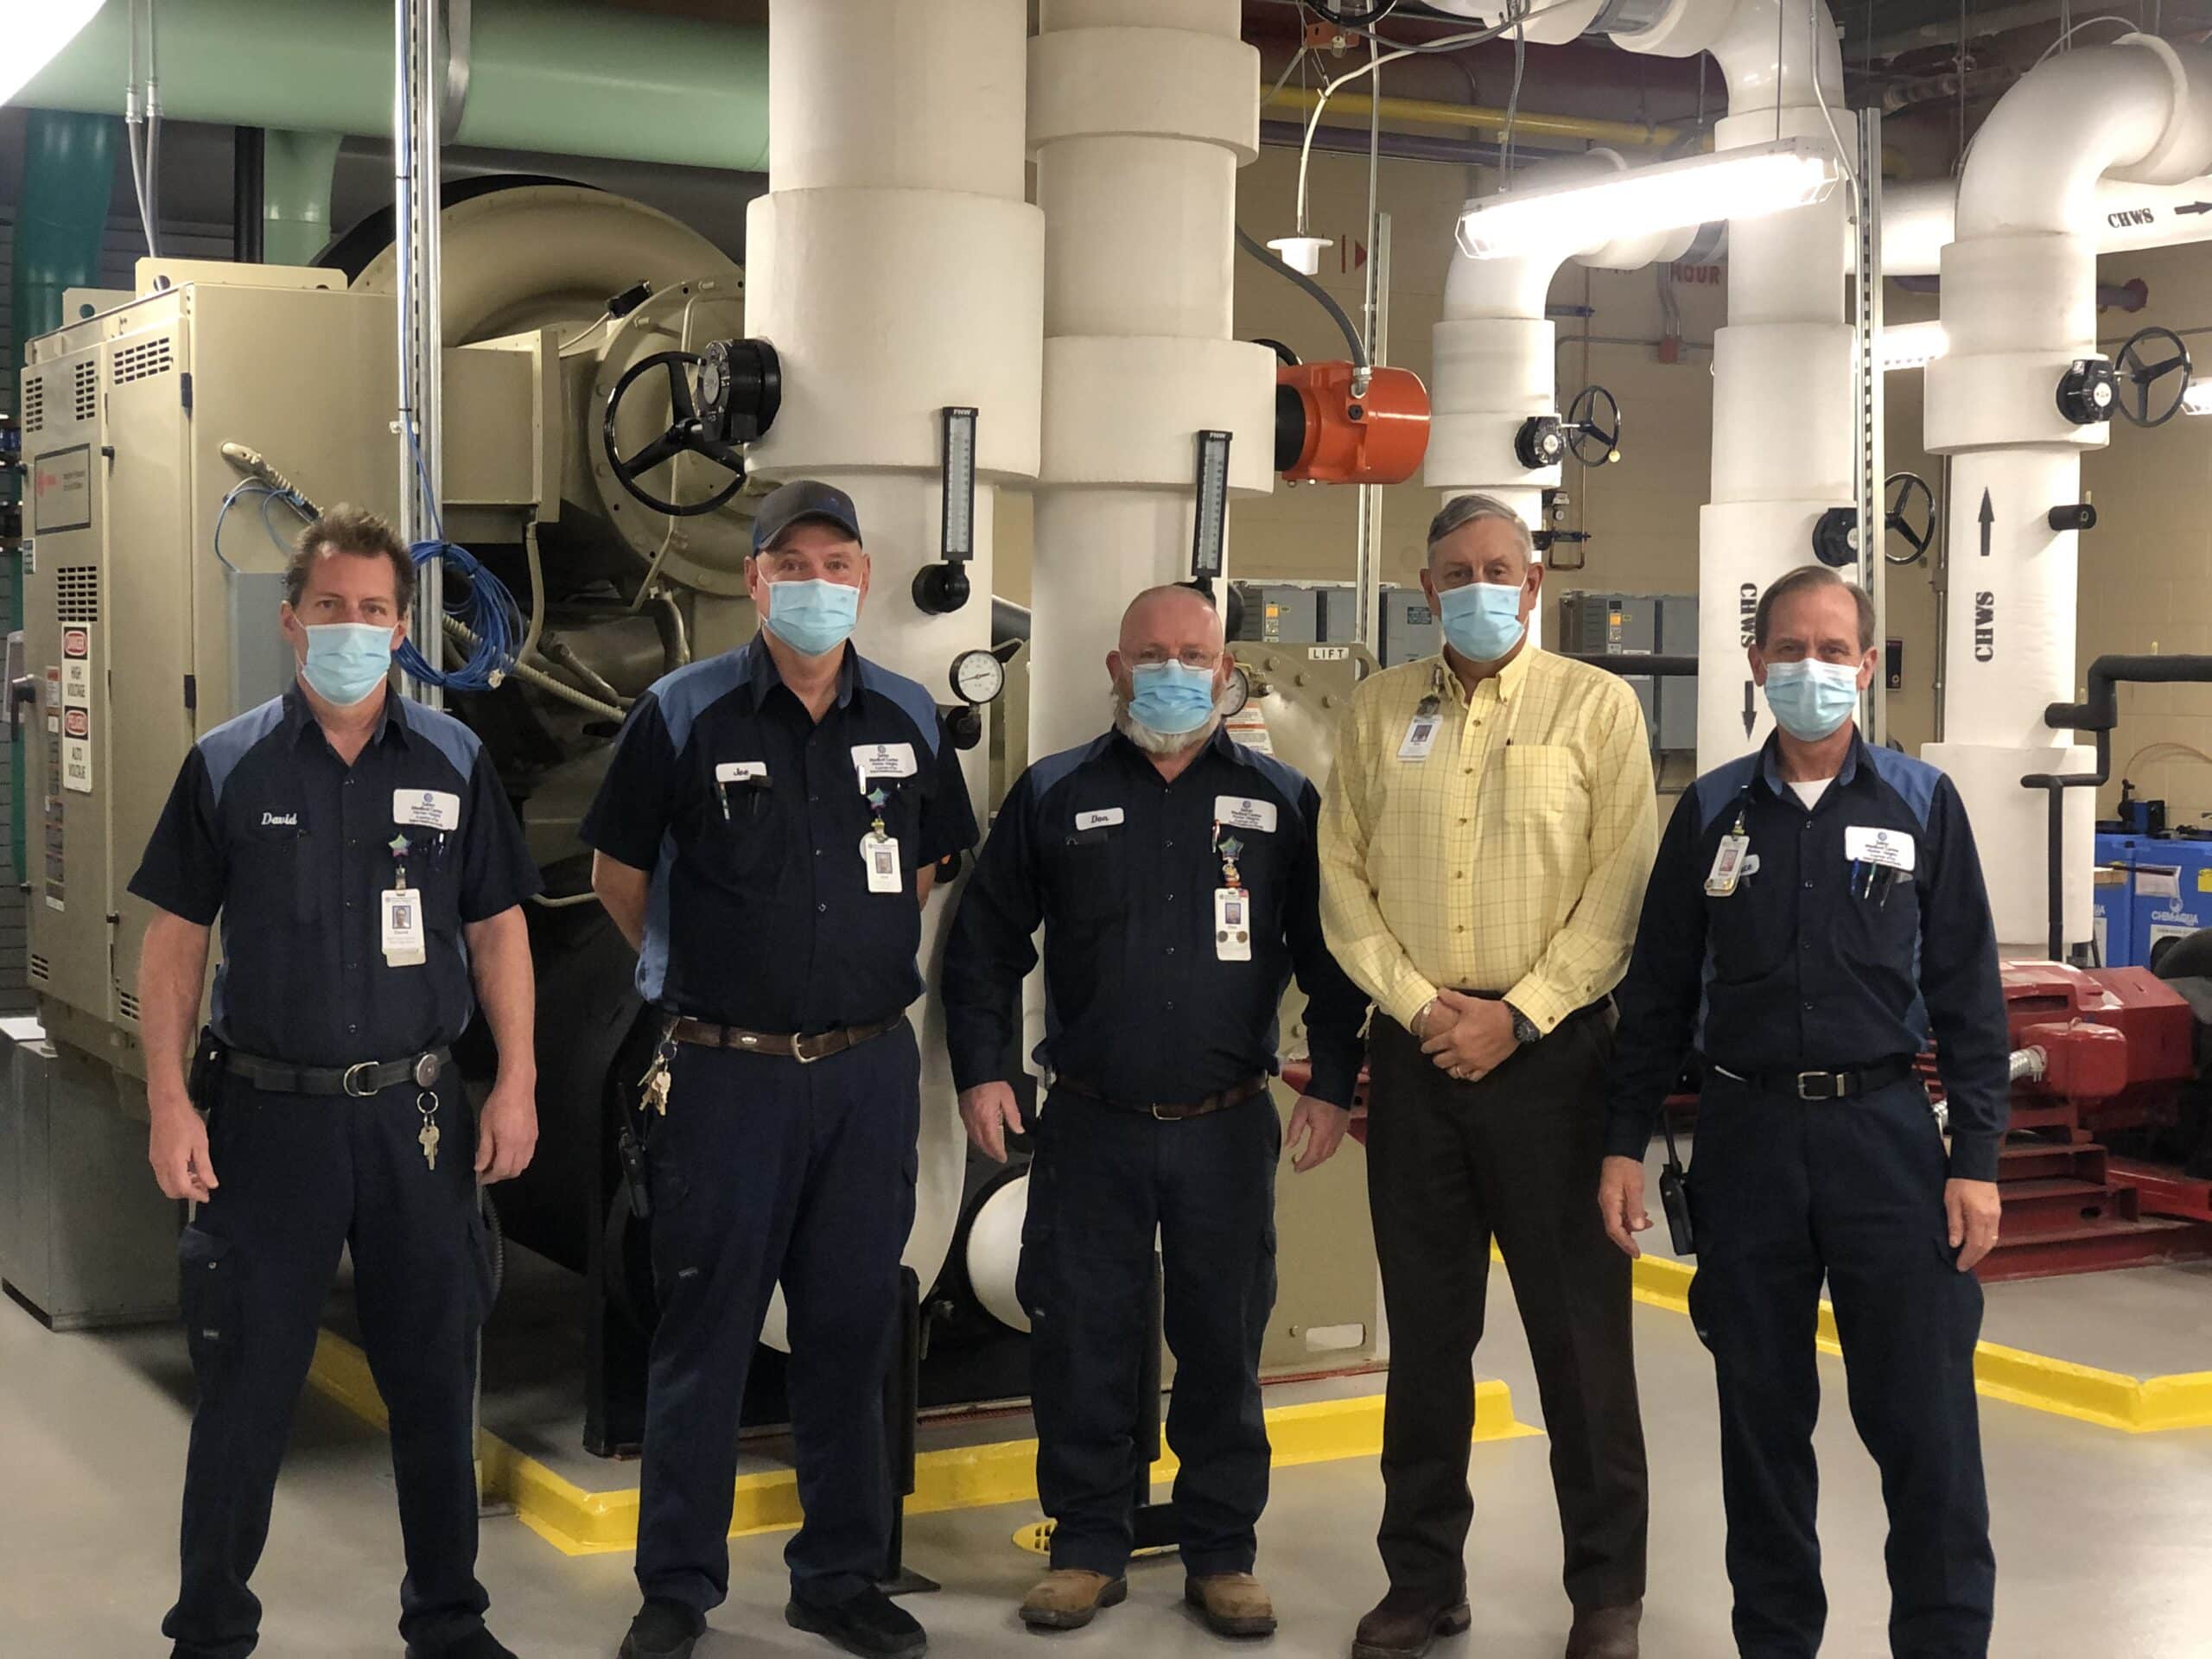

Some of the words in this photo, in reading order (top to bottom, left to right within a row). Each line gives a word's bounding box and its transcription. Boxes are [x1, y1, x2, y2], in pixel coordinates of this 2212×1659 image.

[2107, 207, 2155, 228] CHWS
[1670, 263, 1720, 284] HOUR
[1740, 582, 1758, 648] CHWS
[1975, 591, 1994, 663] CHWS
[1313, 649, 1344, 659] LIFT
[734, 767, 749, 776] Joe
[261, 812, 297, 825] David
